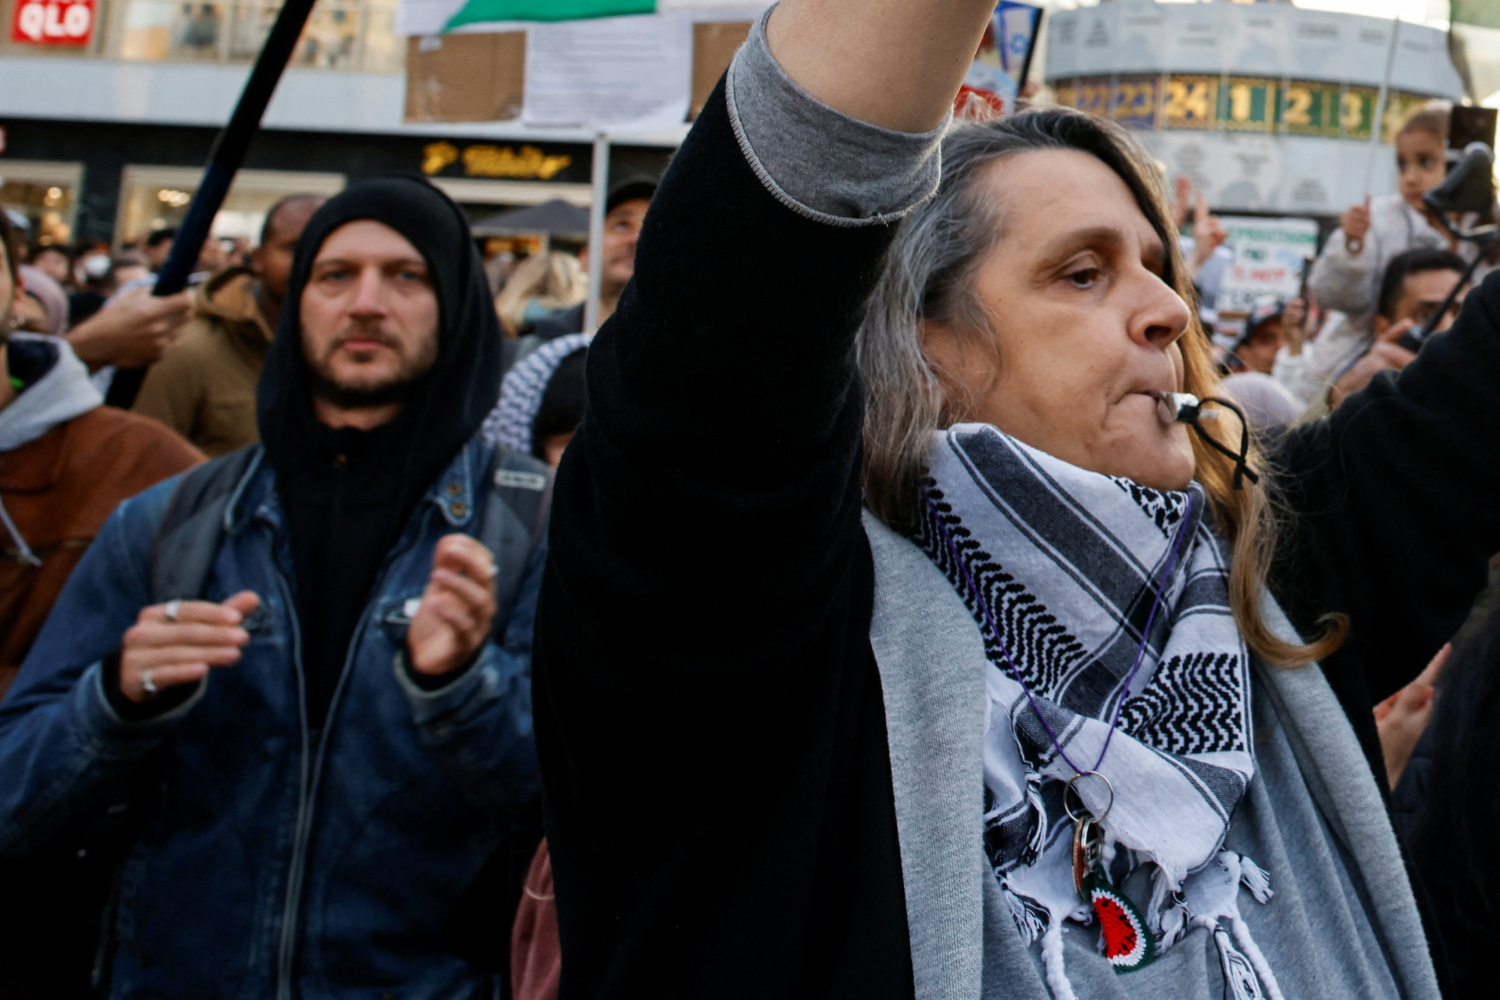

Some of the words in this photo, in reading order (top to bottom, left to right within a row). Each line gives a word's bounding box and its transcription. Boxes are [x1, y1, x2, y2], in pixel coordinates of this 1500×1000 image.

[19, 1, 90, 40] QLO
[1115, 81, 1152, 117] 23
[1167, 81, 1209, 121] 24
[1230, 83, 1251, 121] 1
[1284, 87, 1312, 124] 2
[1342, 91, 1363, 129] 3
